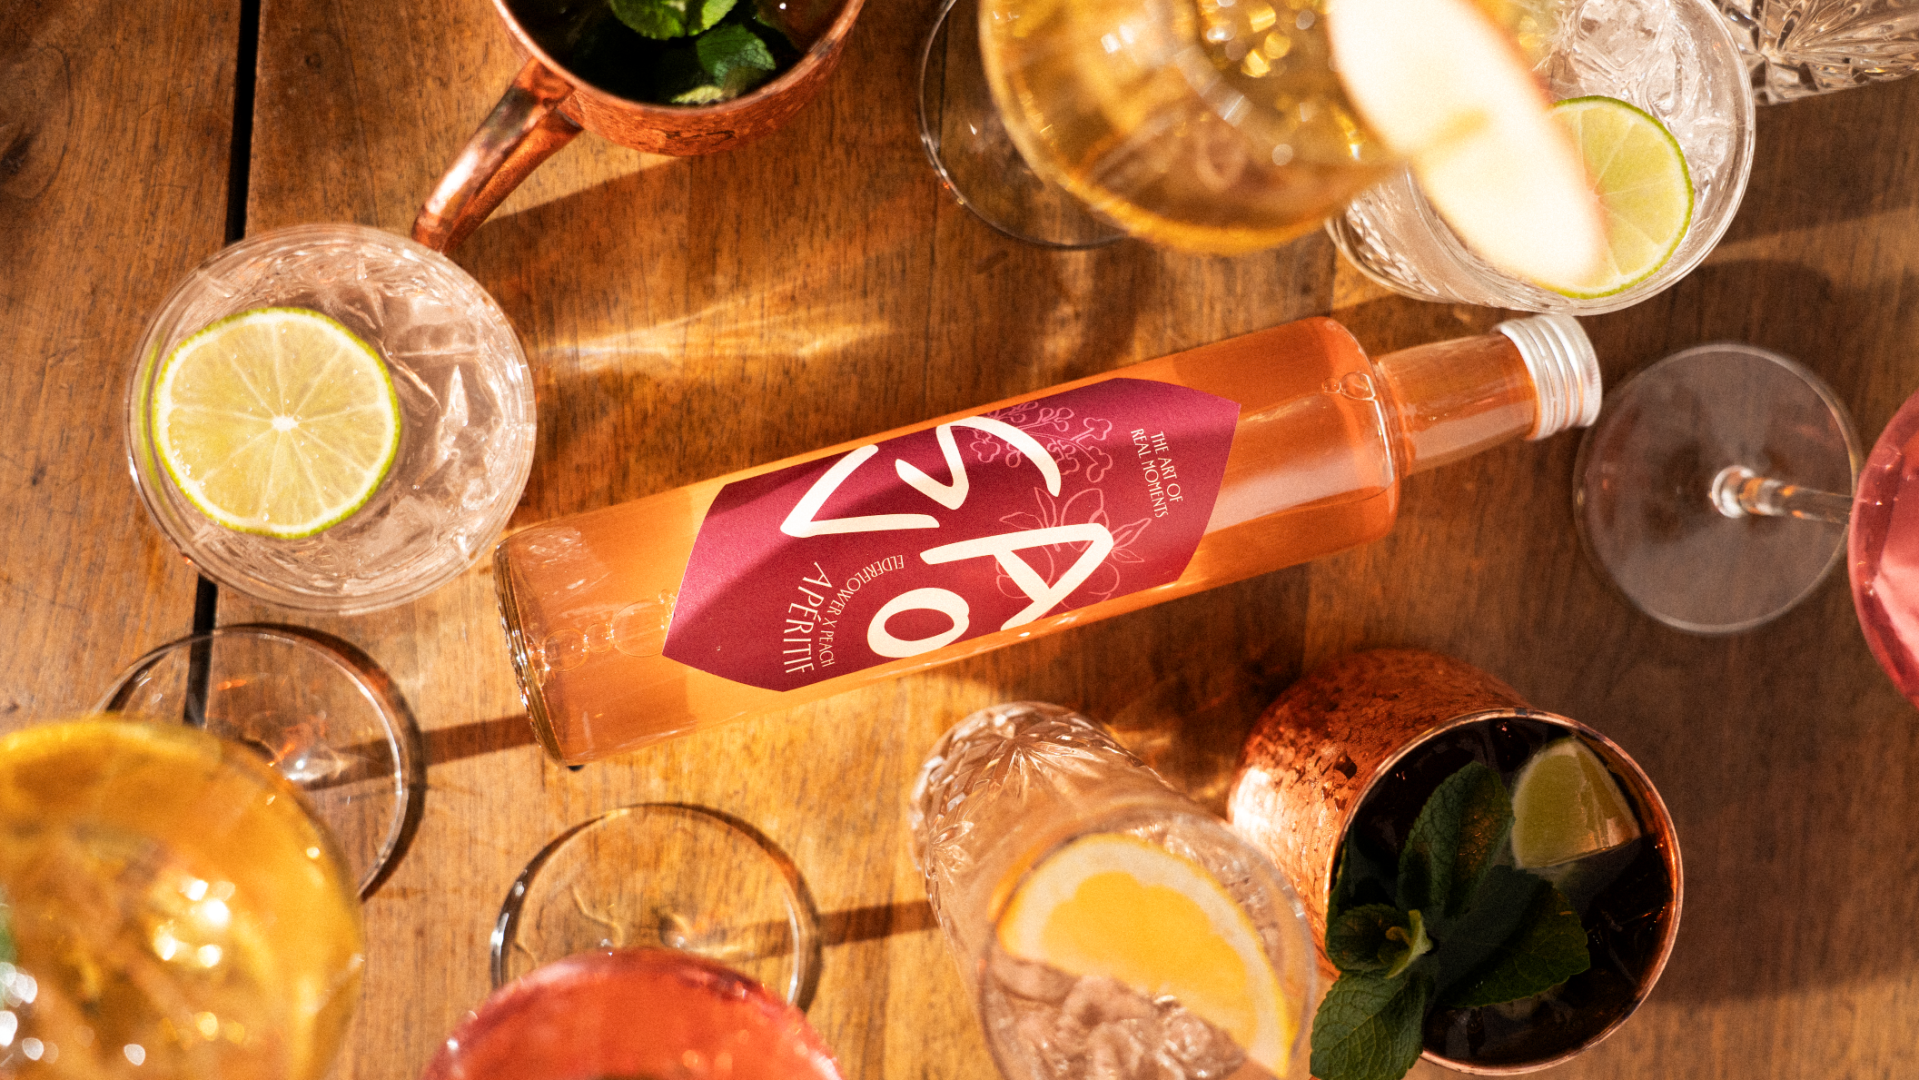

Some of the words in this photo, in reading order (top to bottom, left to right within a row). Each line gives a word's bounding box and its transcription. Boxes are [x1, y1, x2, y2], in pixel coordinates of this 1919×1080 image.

[1150, 430, 1169, 454] THE
[1130, 428, 1151, 459] REAL
[1141, 460, 1168, 518] MOMENTS
[1157, 457, 1177, 480] ART
[1166, 483, 1183, 502] OF
[827, 554, 904, 616] ELDERFLOWER
[783, 561, 832, 673] APÉRITIF
[819, 630, 835, 668] PEACH
